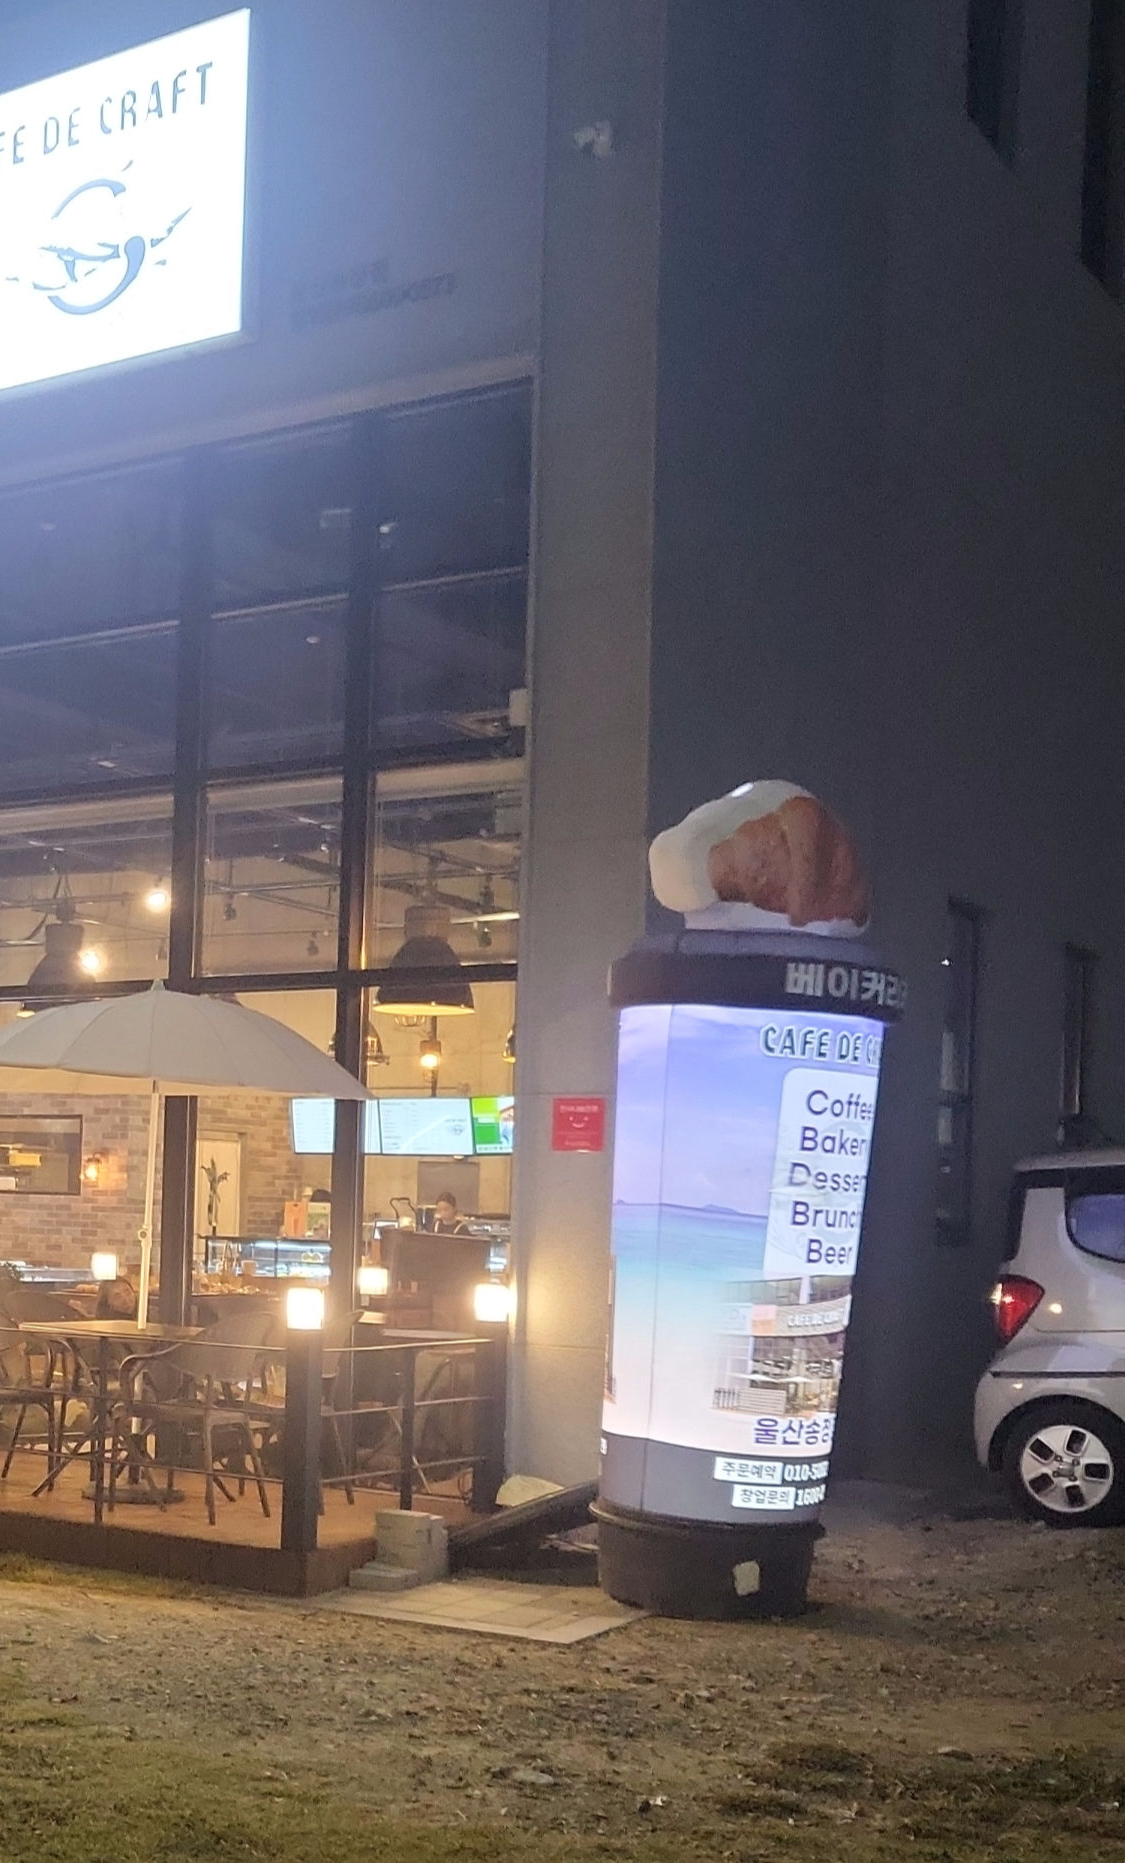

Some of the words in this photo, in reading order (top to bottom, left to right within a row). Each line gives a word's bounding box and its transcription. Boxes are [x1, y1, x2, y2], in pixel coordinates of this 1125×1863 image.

[43, 107, 81, 155] DE
[100, 61, 213, 134] CRAFT
[761, 1023, 831, 1061] CAFE
[837, 1031, 862, 1063] DE
[800, 1126, 868, 1157] Baker
[788, 1162, 867, 1193] Desser
[805, 1238, 852, 1265] Beer
